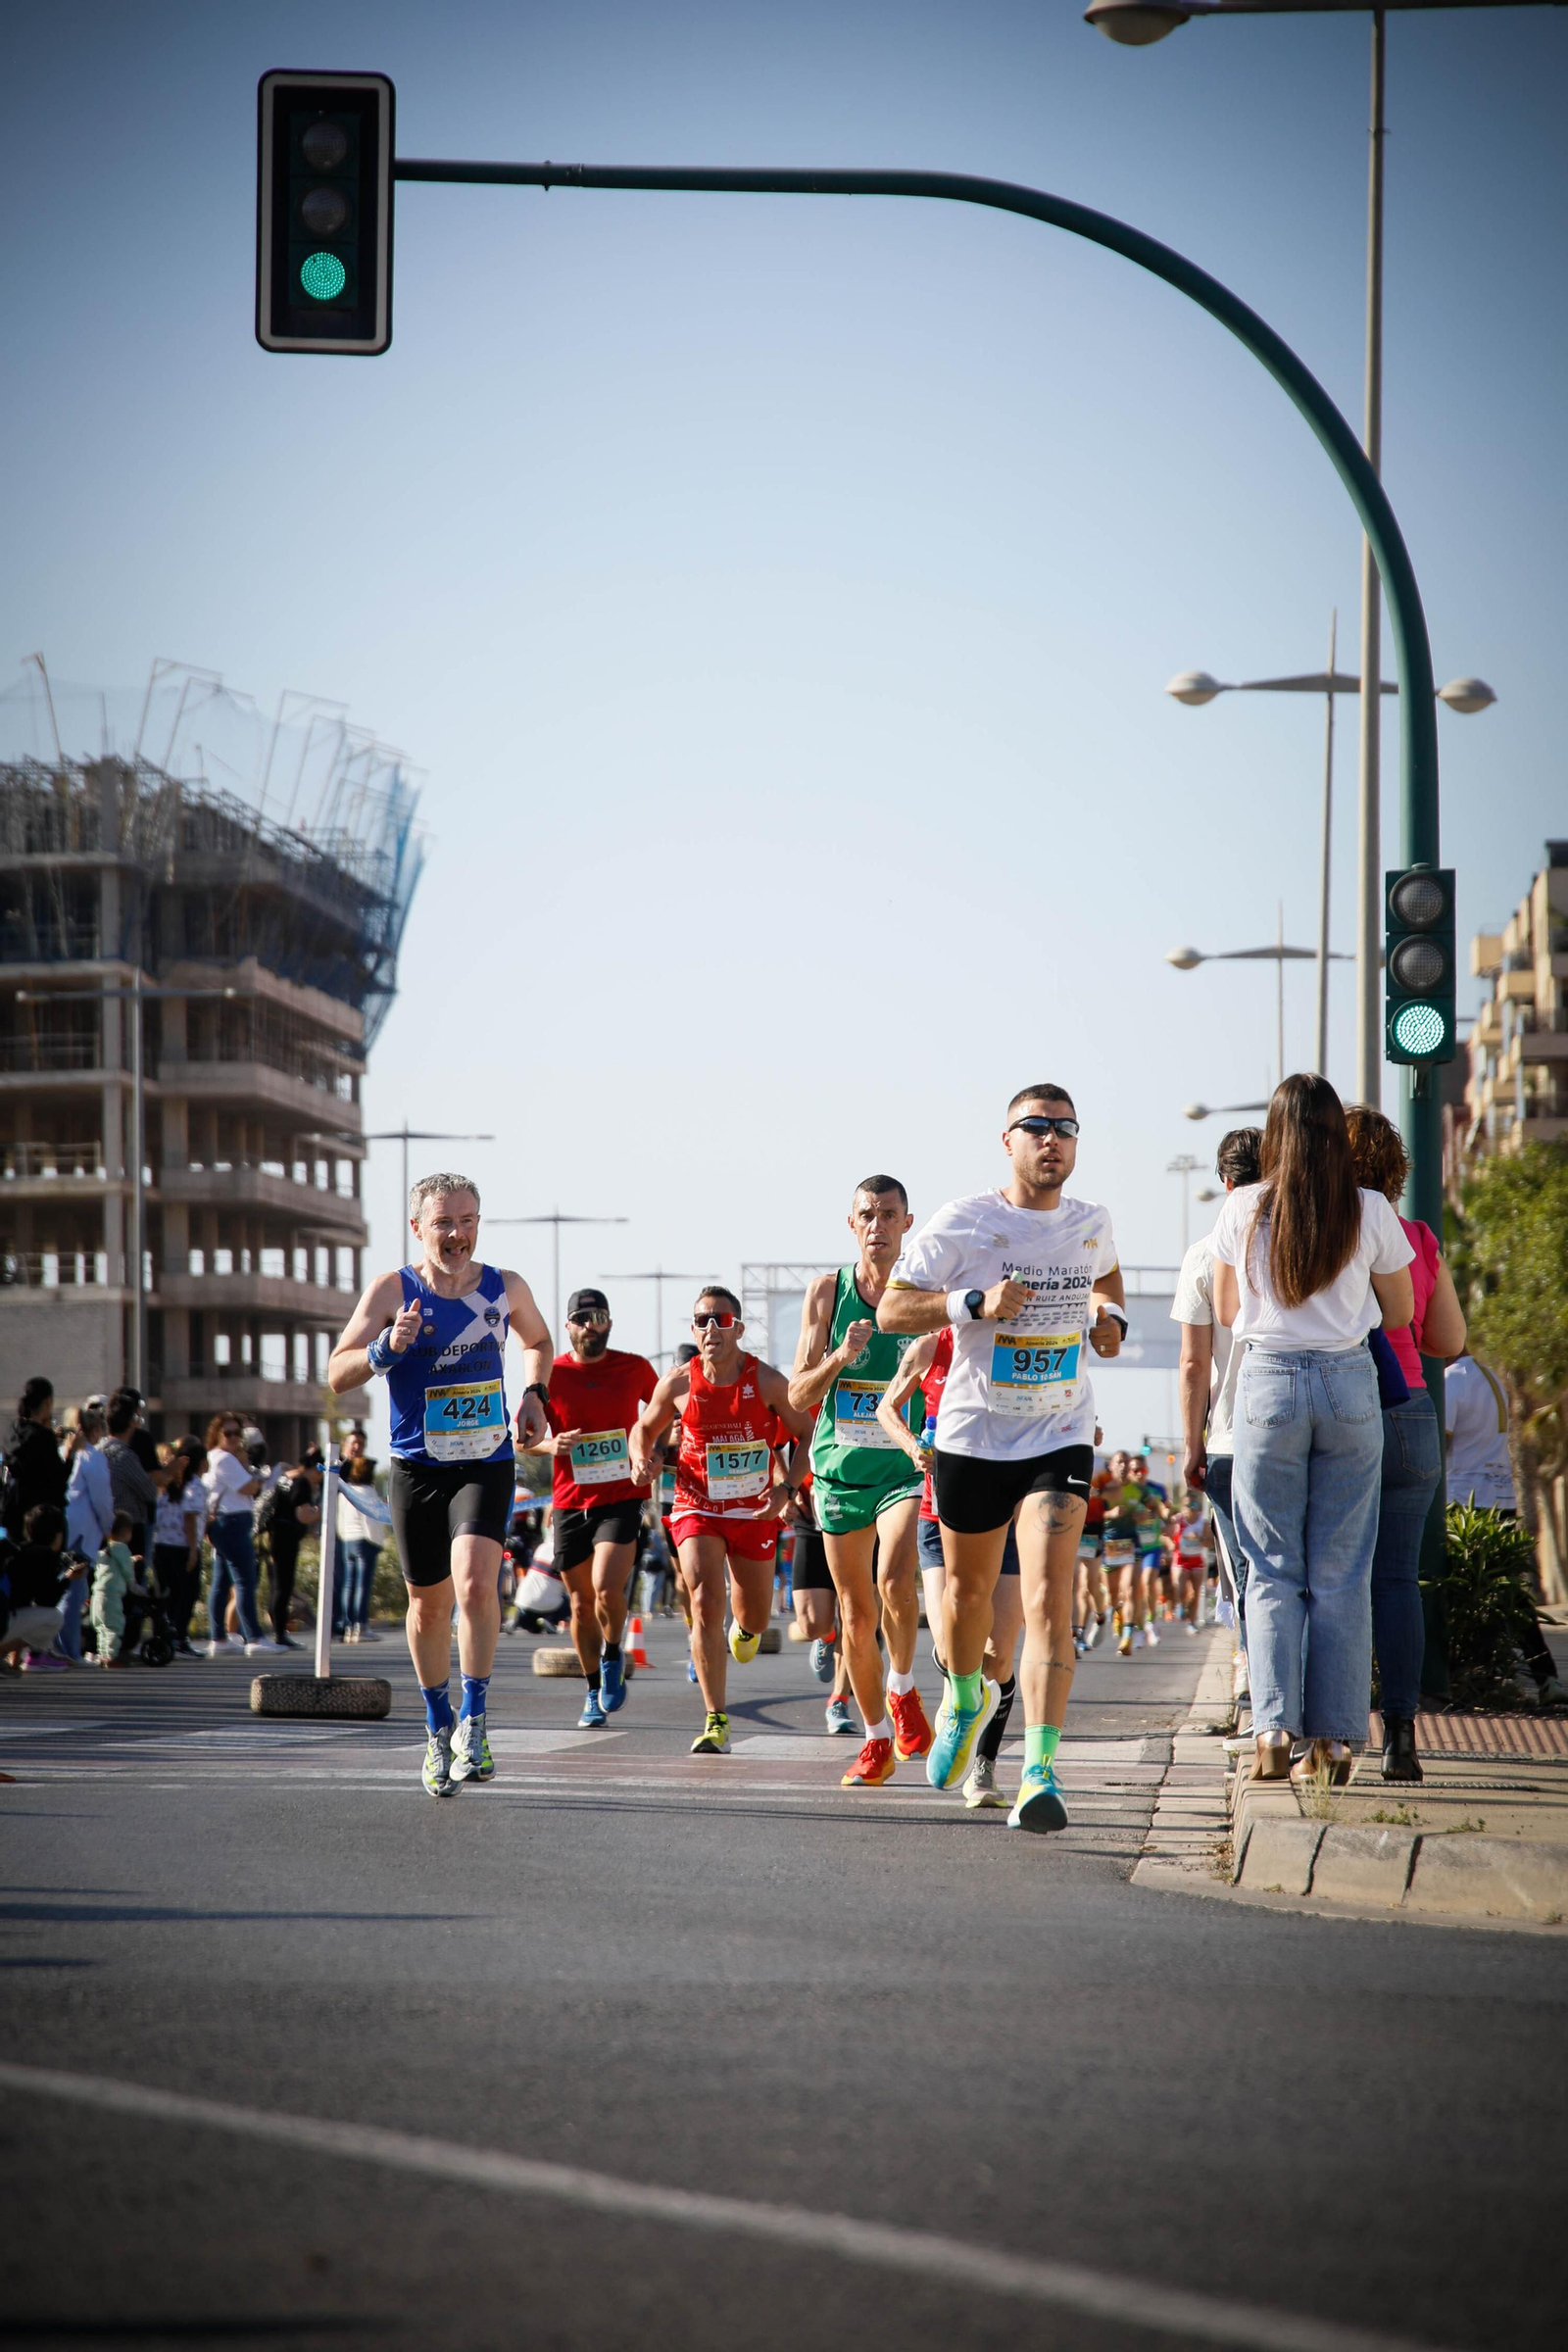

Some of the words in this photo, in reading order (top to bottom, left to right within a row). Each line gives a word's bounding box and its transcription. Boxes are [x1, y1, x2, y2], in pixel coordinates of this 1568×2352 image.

[1002, 1261, 1043, 1276] Medio
[1049, 1263, 1093, 1276] Maratón
[1062, 1276, 1092, 1290] 2024
[1012, 1348, 1068, 1373] 957
[1012, 1372, 1038, 1381] PABLO
[443, 1395, 491, 1420] 424
[457, 1419, 479, 1428] JORGE
[576, 1439, 622, 1458] 1260
[714, 1449, 763, 1469] 1577
